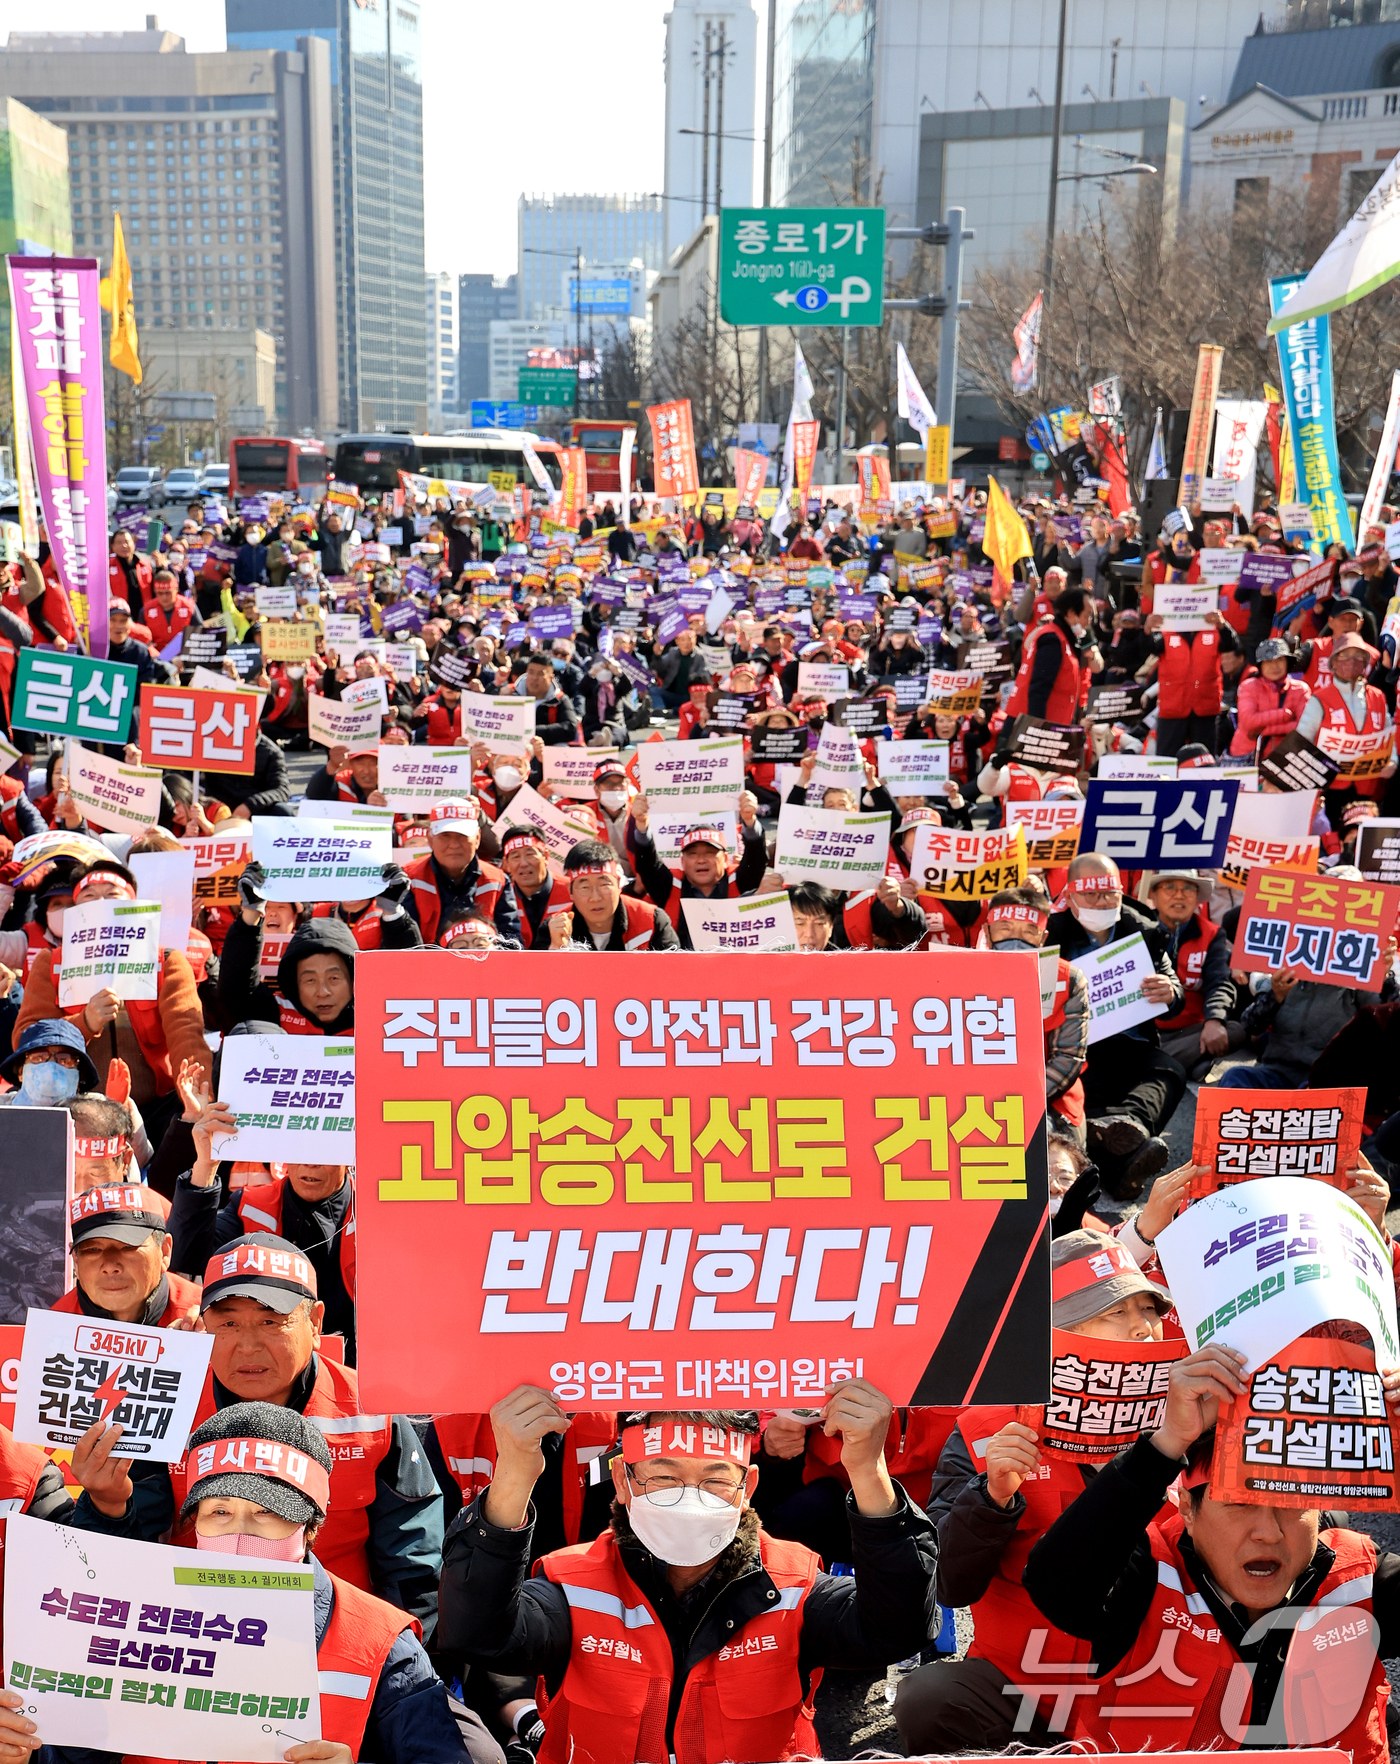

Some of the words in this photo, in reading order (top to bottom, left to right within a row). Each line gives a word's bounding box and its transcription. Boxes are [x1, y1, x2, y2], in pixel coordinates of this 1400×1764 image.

[734, 220, 868, 254] 종로1가
[732, 260, 784, 283] Jongno
[788, 260, 835, 283] 1(il)-ga
[805, 289, 819, 308] 6
[23, 271, 87, 374] 전자파
[37, 381, 90, 481] 살인마
[930, 674, 981, 692] 주민무시
[25, 660, 129, 732] 금산
[149, 695, 250, 762] 금산
[392, 764, 420, 774] 수도권
[422, 765, 458, 774] 전력수요
[655, 761, 685, 772] 수도권
[688, 758, 728, 769] 전력수요
[407, 777, 443, 785] 분산하고
[645, 787, 681, 796] 민주적인
[683, 786, 700, 794] 절차
[703, 783, 741, 794] 마련하라!
[672, 773, 712, 783] 분산하고
[382, 787, 414, 797] 민주적인
[416, 788, 431, 797] 절차
[434, 788, 469, 797] 마련하라!
[435, 808, 476, 819] 결사반대
[1013, 808, 1078, 831] 주민무
[1094, 789, 1229, 858] 금산
[658, 826, 686, 835] 수도권
[683, 829, 720, 843] 결사반대
[793, 828, 827, 842] 수도권
[830, 832, 875, 845] 전력수요
[273, 838, 314, 848] 수도권
[318, 838, 372, 849] 전력수요
[504, 836, 533, 854] 결사반대
[810, 845, 855, 857] 분산하고
[926, 833, 1018, 863] 주민없는
[1227, 835, 1313, 866] 주민무시
[295, 852, 350, 863] 분산하고
[778, 856, 817, 868] 민주적인
[820, 861, 839, 870] 절차
[842, 861, 884, 871] 마련하라!
[308, 867, 333, 877] 절차
[923, 864, 1020, 895] 입지선정
[1074, 876, 1118, 892] 결사반대
[1255, 874, 1385, 927] 무조건
[702, 920, 727, 932] 수도권
[730, 917, 776, 932] 전력수요
[993, 906, 1039, 924] 결사반대
[70, 928, 96, 944] 수도권
[100, 926, 146, 939] 전력수요
[444, 922, 488, 943] 결사반대
[84, 944, 129, 959] 분산하고
[1245, 918, 1380, 983] 백지화
[61, 964, 92, 981] 민주적인
[94, 963, 115, 976] 절차
[118, 962, 155, 975] 마련하라!
[1091, 959, 1135, 987] 전력수요
[383, 998, 598, 1067] 주민들의
[613, 998, 777, 1067] 안전과
[791, 998, 898, 1067] 건강
[912, 995, 1018, 1066] 위협
[244, 1068, 297, 1085] 수도권
[301, 1069, 355, 1087] 전력수
[271, 1091, 343, 1109] 분산하고
[231, 1113, 283, 1130] 주적인
[286, 1115, 318, 1130] 절차
[1219, 1108, 1342, 1140] 송전철탑
[75, 1137, 119, 1156] 사반대
[378, 1095, 851, 1206] 고압송전선로
[874, 1095, 1028, 1201] 건설
[1217, 1144, 1337, 1176] 건설반대
[72, 1188, 143, 1220] 결사반대
[1204, 1214, 1288, 1269] 수도권
[222, 1245, 309, 1280] 결사반대
[479, 1224, 934, 1333] 반대한다!
[1196, 1271, 1285, 1349] 민주적인
[90, 1332, 148, 1357] 345kV
[549, 1360, 664, 1401] 영암군
[1052, 1355, 1171, 1397] 송전철탑
[1251, 1366, 1385, 1417] 송전철탑
[1046, 1394, 1165, 1434] 건설반대
[329, 1446, 366, 1461] 전선로
[642, 1424, 745, 1460] 결사반대
[1050, 1439, 1061, 1448] 고압
[1244, 1419, 1393, 1470] 건설반대
[197, 1442, 308, 1485] 결사반대
[1253, 1480, 1267, 1489] 고압
[1300, 1484, 1342, 1495] 철탑건설반대
[1343, 1486, 1388, 1496] 영암군대책위원회
[197, 1572, 236, 1584] 전국행동
[240, 1574, 258, 1584] 3.4
[261, 1575, 302, 1587] 궐기대회
[40, 1587, 131, 1629] 수도권
[138, 1604, 268, 1647] 전력수요
[1311, 1618, 1369, 1652] 송전선로
[87, 1635, 217, 1677] 분산하고
[580, 1634, 643, 1664] 송전철탑
[717, 1634, 779, 1662] 송전선로
[9, 1661, 113, 1700] 민주적인
[121, 1679, 177, 1708] 절차
[184, 1687, 310, 1720] 마련하라!
